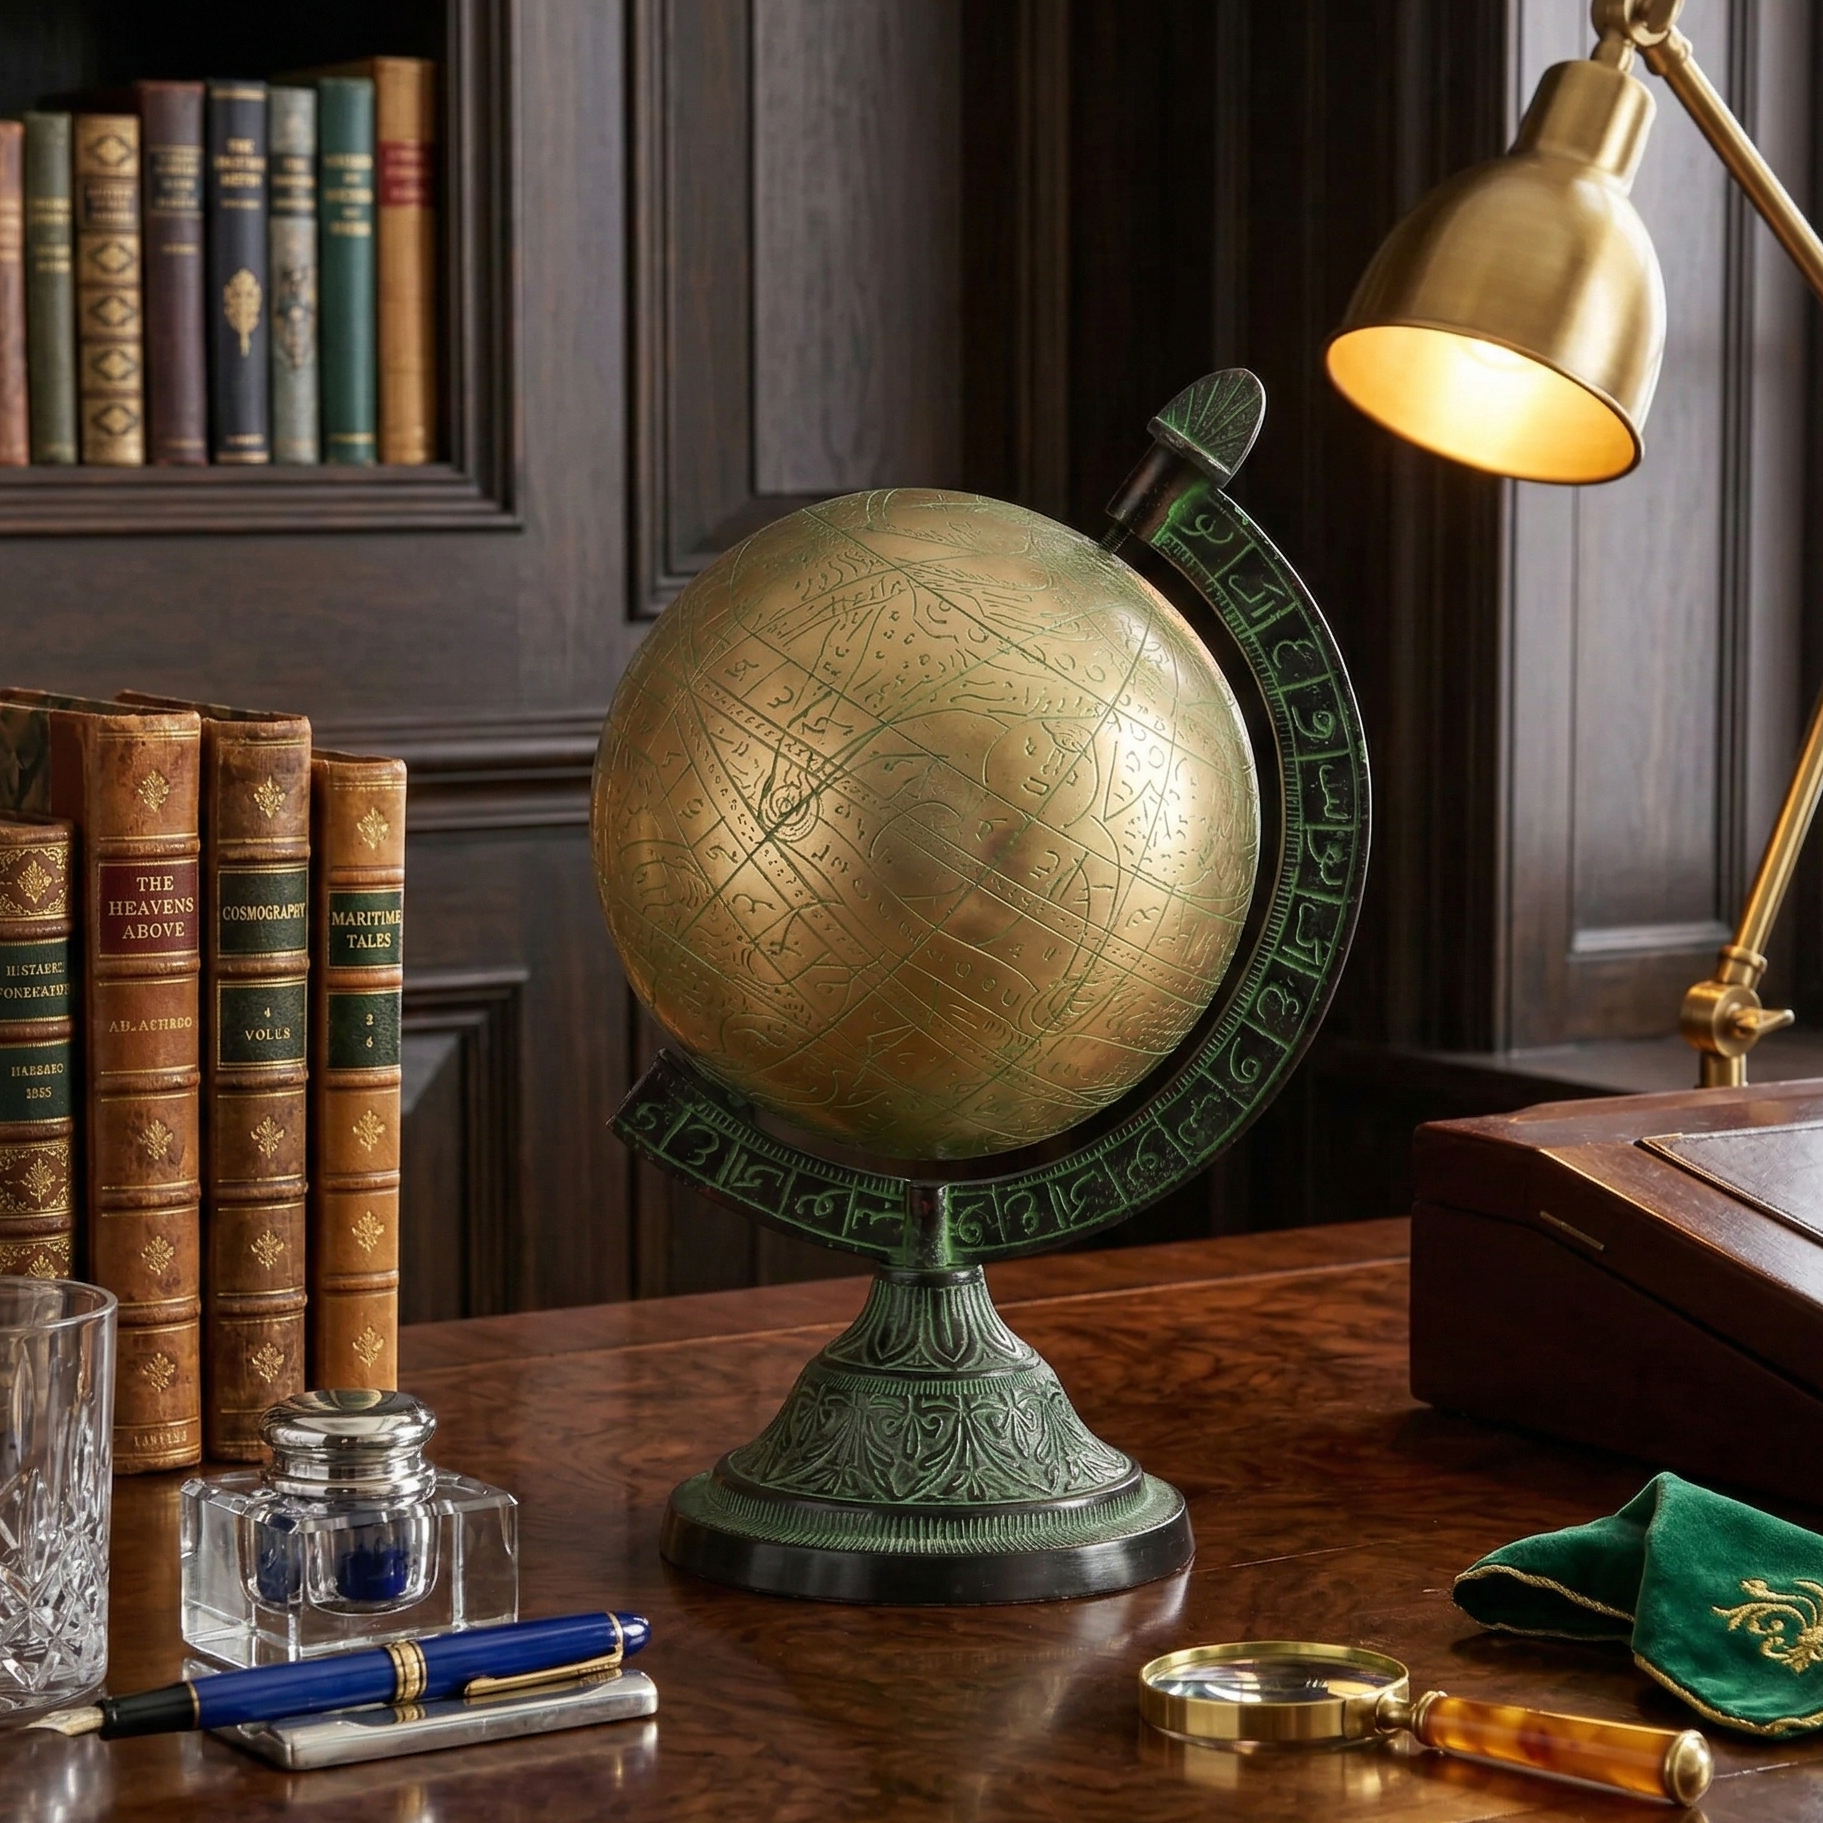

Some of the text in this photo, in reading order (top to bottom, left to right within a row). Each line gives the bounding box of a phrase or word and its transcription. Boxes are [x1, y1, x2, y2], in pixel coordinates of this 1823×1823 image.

[136, 875, 174, 892] THE
[108, 897, 194, 916] HEAVENS
[331, 909, 401, 926] MARITIME
[122, 921, 185, 939] ABOVE
[346, 932, 391, 949] TALES
